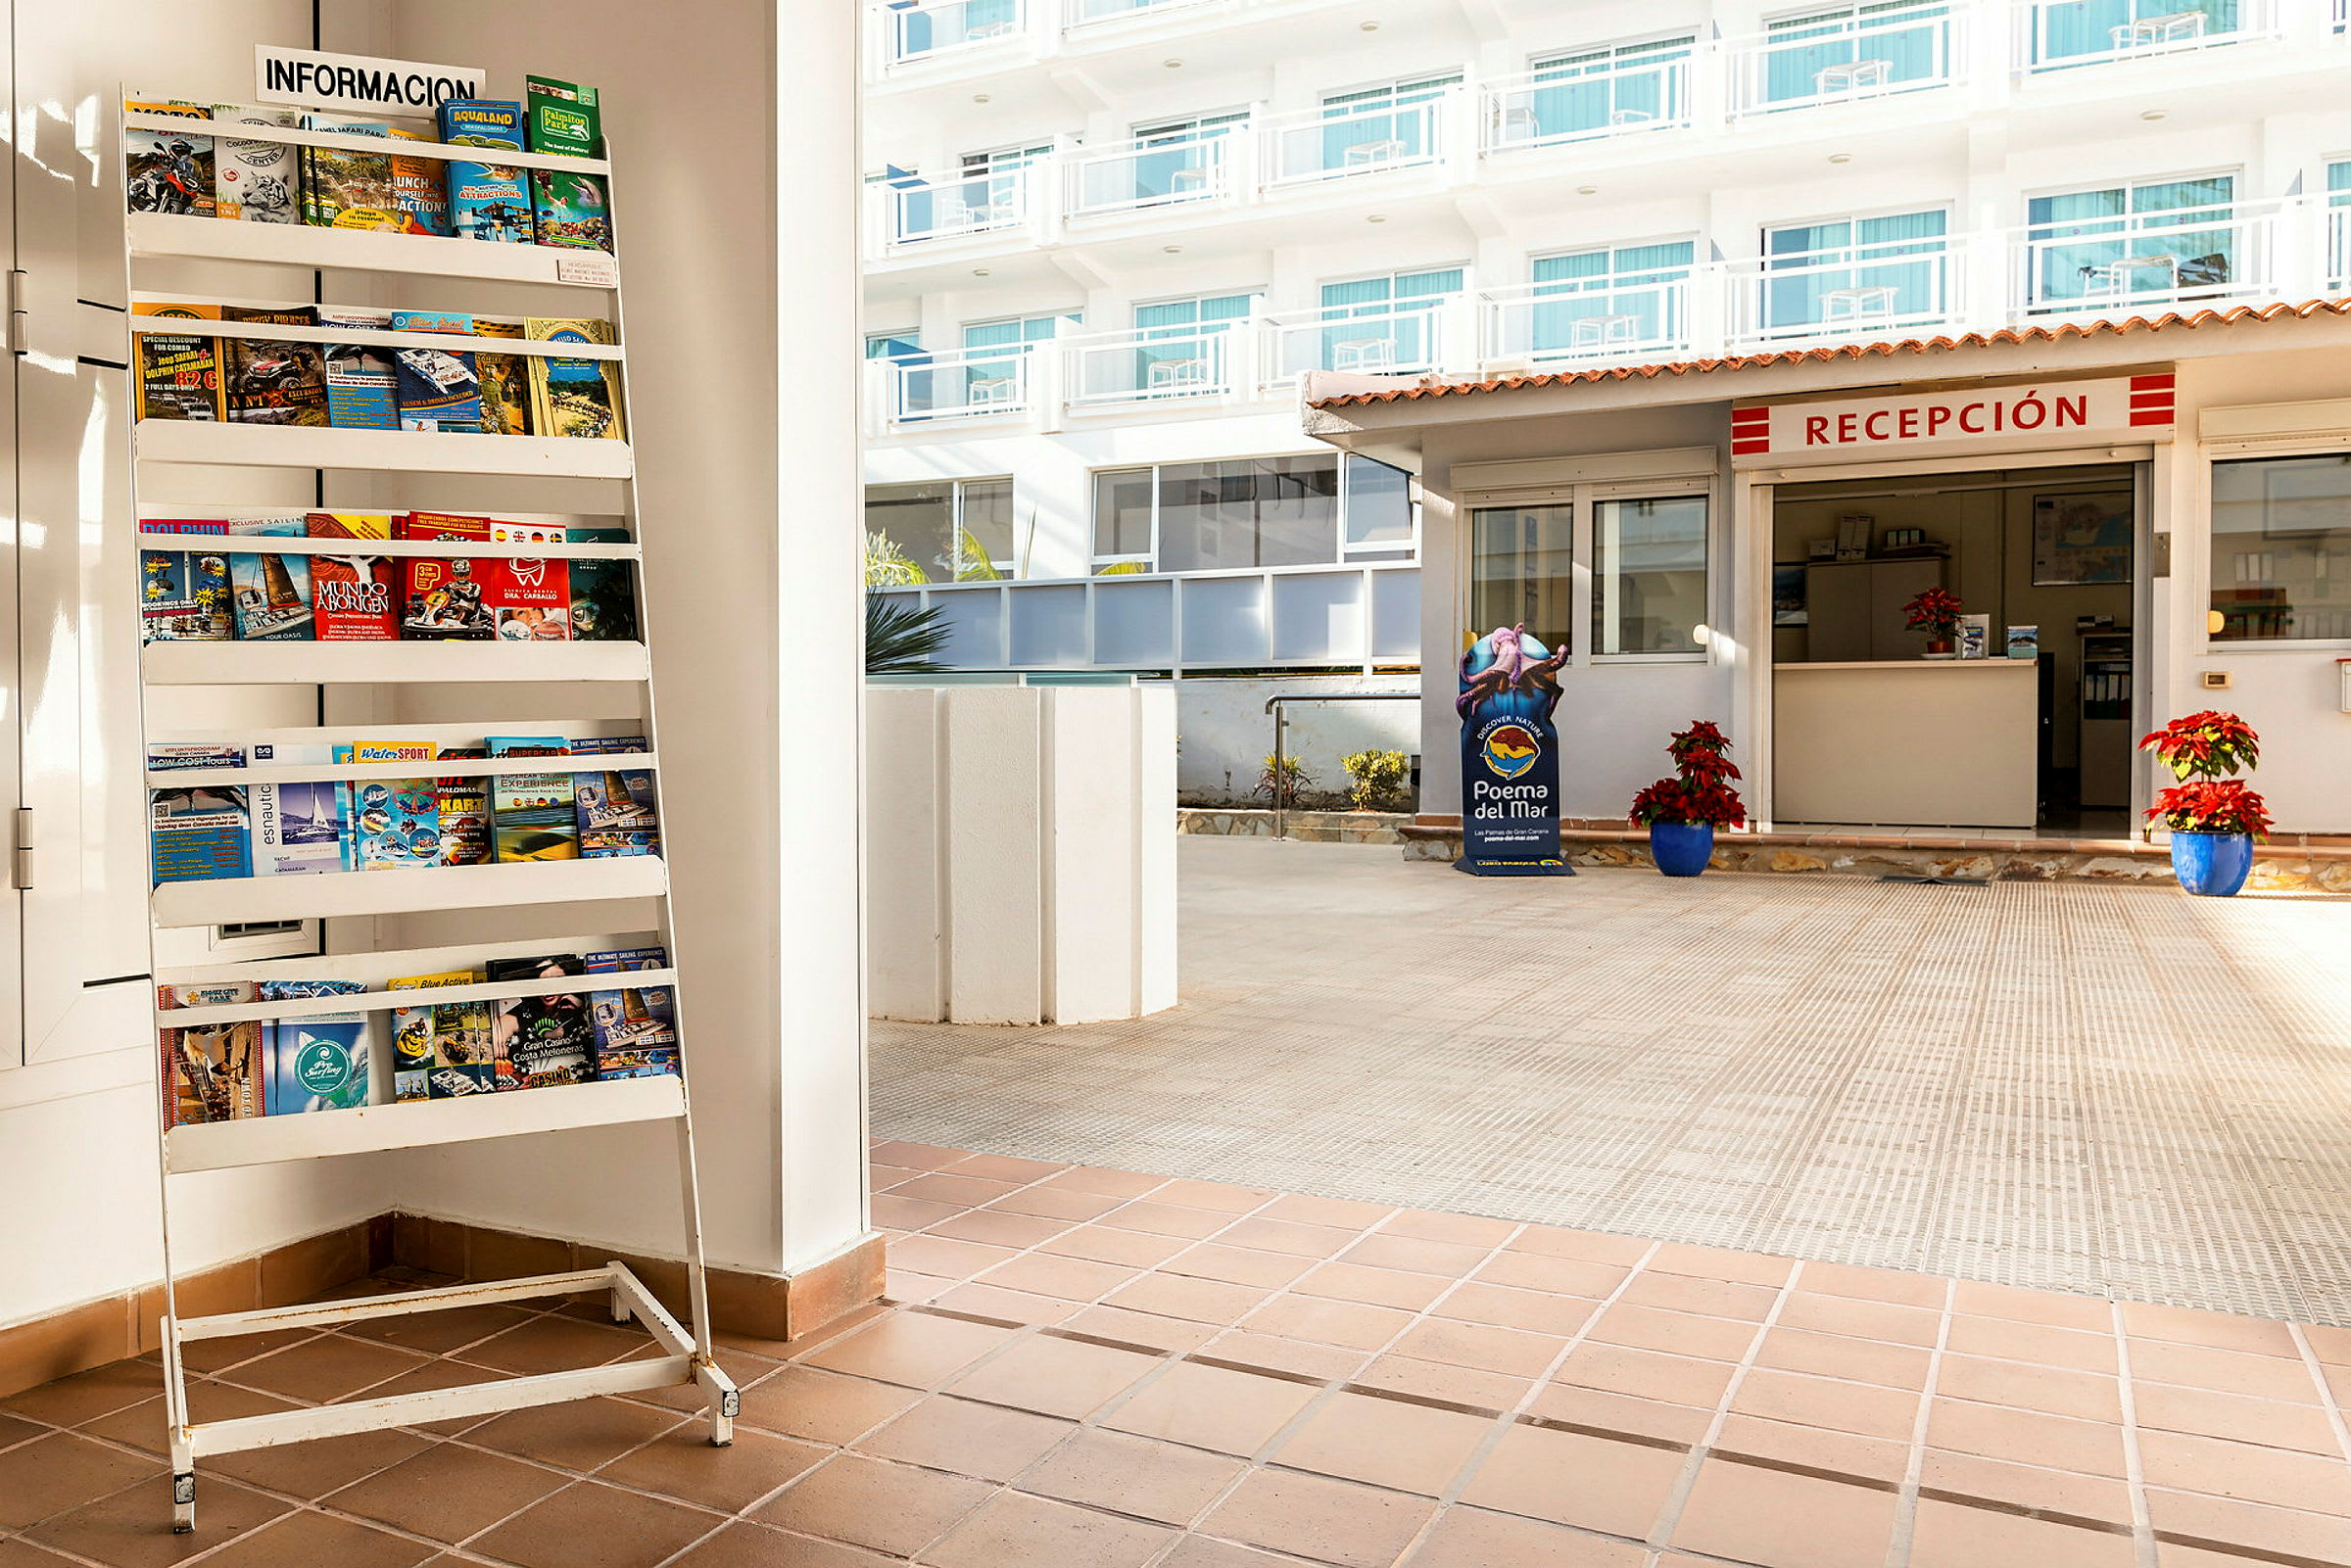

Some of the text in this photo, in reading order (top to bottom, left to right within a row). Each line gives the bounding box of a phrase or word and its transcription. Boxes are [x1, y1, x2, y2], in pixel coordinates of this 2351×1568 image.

[265, 58, 476, 105] INFORMACION
[454, 110, 513, 125] AQUALAND
[544, 109, 585, 126] Palmitos
[545, 117, 568, 130] Park
[246, 151, 280, 166] CENTER
[459, 190, 522, 199] ATTRACTIONS
[398, 201, 447, 213] ACTION!
[174, 351, 198, 363] SAFARI
[145, 366, 174, 379] DOLPHIN
[175, 371, 201, 389] 82
[1806, 389, 2087, 446] RECEPCIÓN
[419, 566, 425, 577] 3
[318, 580, 387, 597] MUNDO
[316, 594, 389, 613] ABORIGEN
[1477, 715, 1545, 739] DISCOVER NATURE
[176, 758, 204, 767] COST
[205, 756, 231, 766] Tours
[1473, 780, 1549, 801] Poema
[440, 798, 485, 812] KART
[1474, 801, 1549, 820] del Mar
[420, 977, 470, 989] Blue Active
[524, 1037, 572, 1051] Gran Casino
[513, 1045, 584, 1062] Costa Meloneras
[304, 1067, 343, 1078] Surfing
[530, 1067, 571, 1089] CASINO
